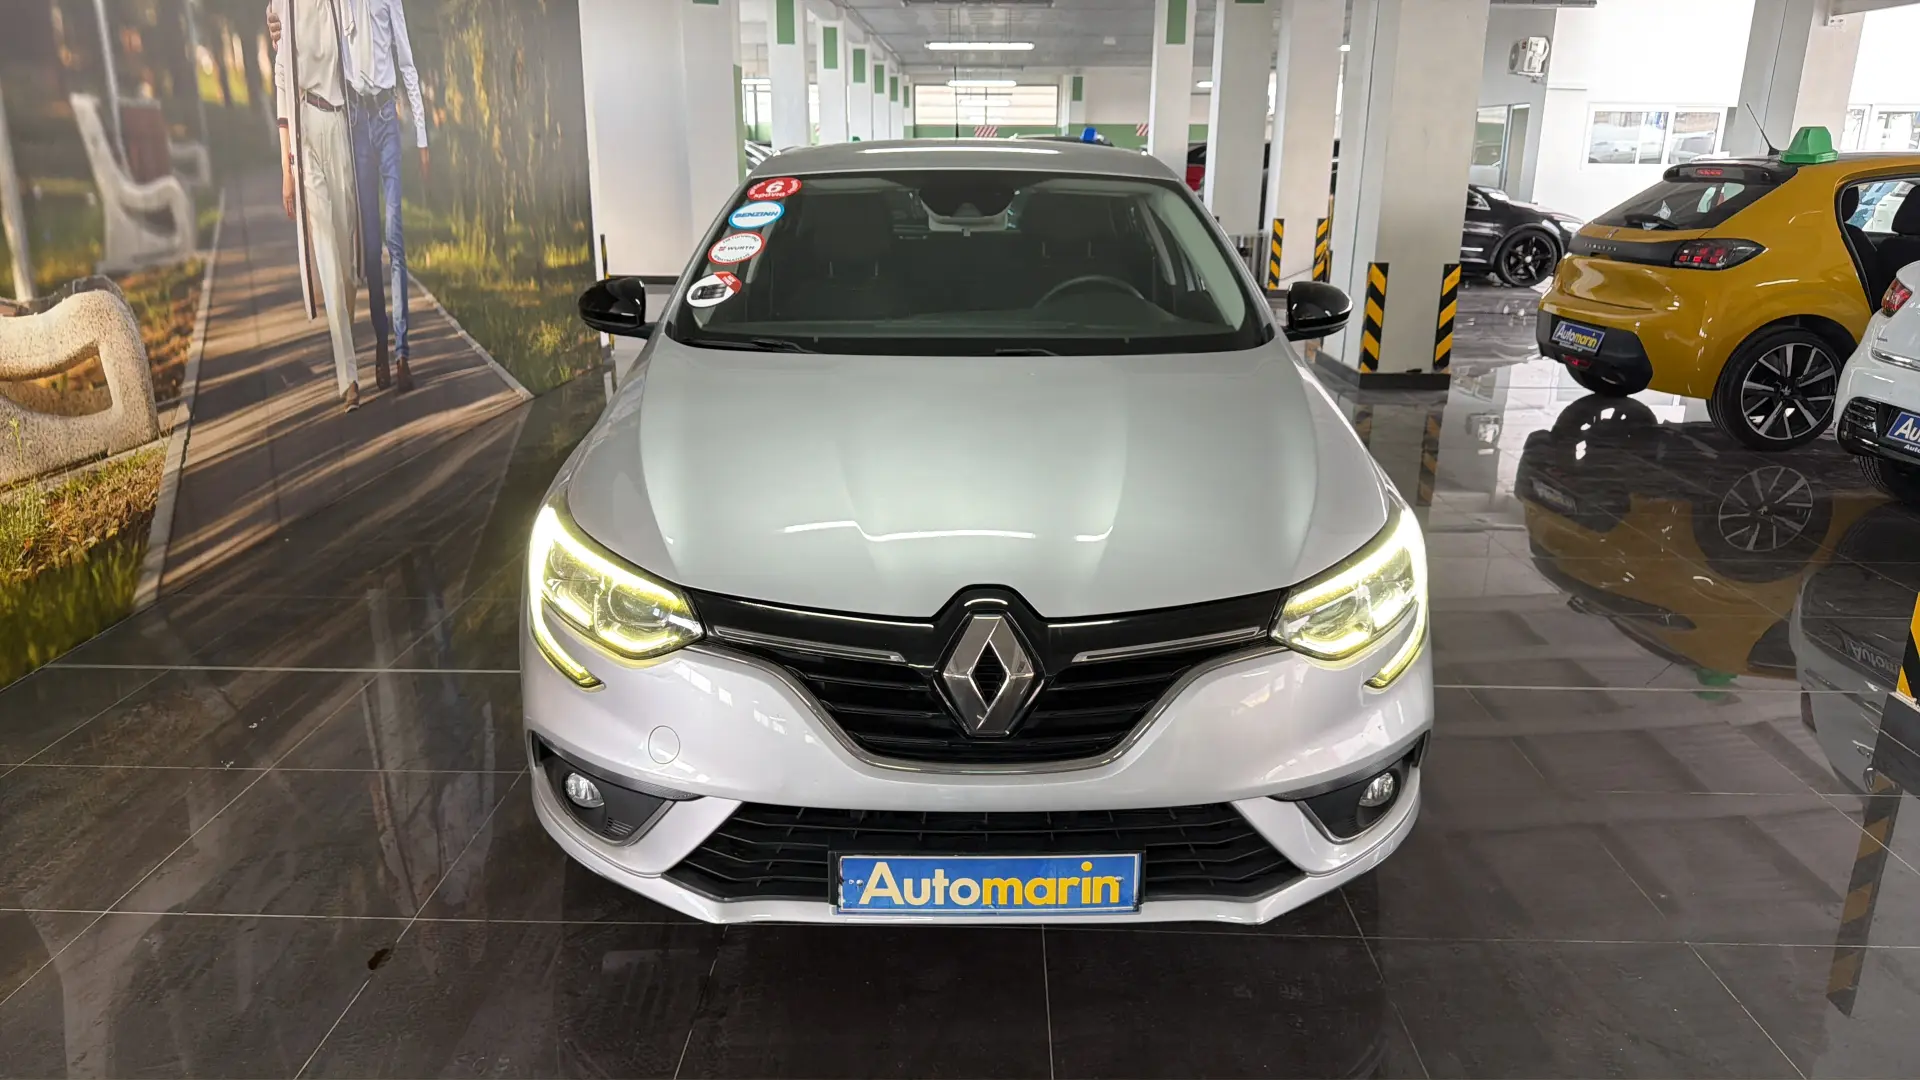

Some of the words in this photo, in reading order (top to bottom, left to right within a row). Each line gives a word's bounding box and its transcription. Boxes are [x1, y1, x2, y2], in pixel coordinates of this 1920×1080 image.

[766, 180, 785, 193] 6
[1555, 324, 1598, 349] Automarin
[1894, 417, 1920, 442] Au
[859, 860, 1121, 906] Automarin
